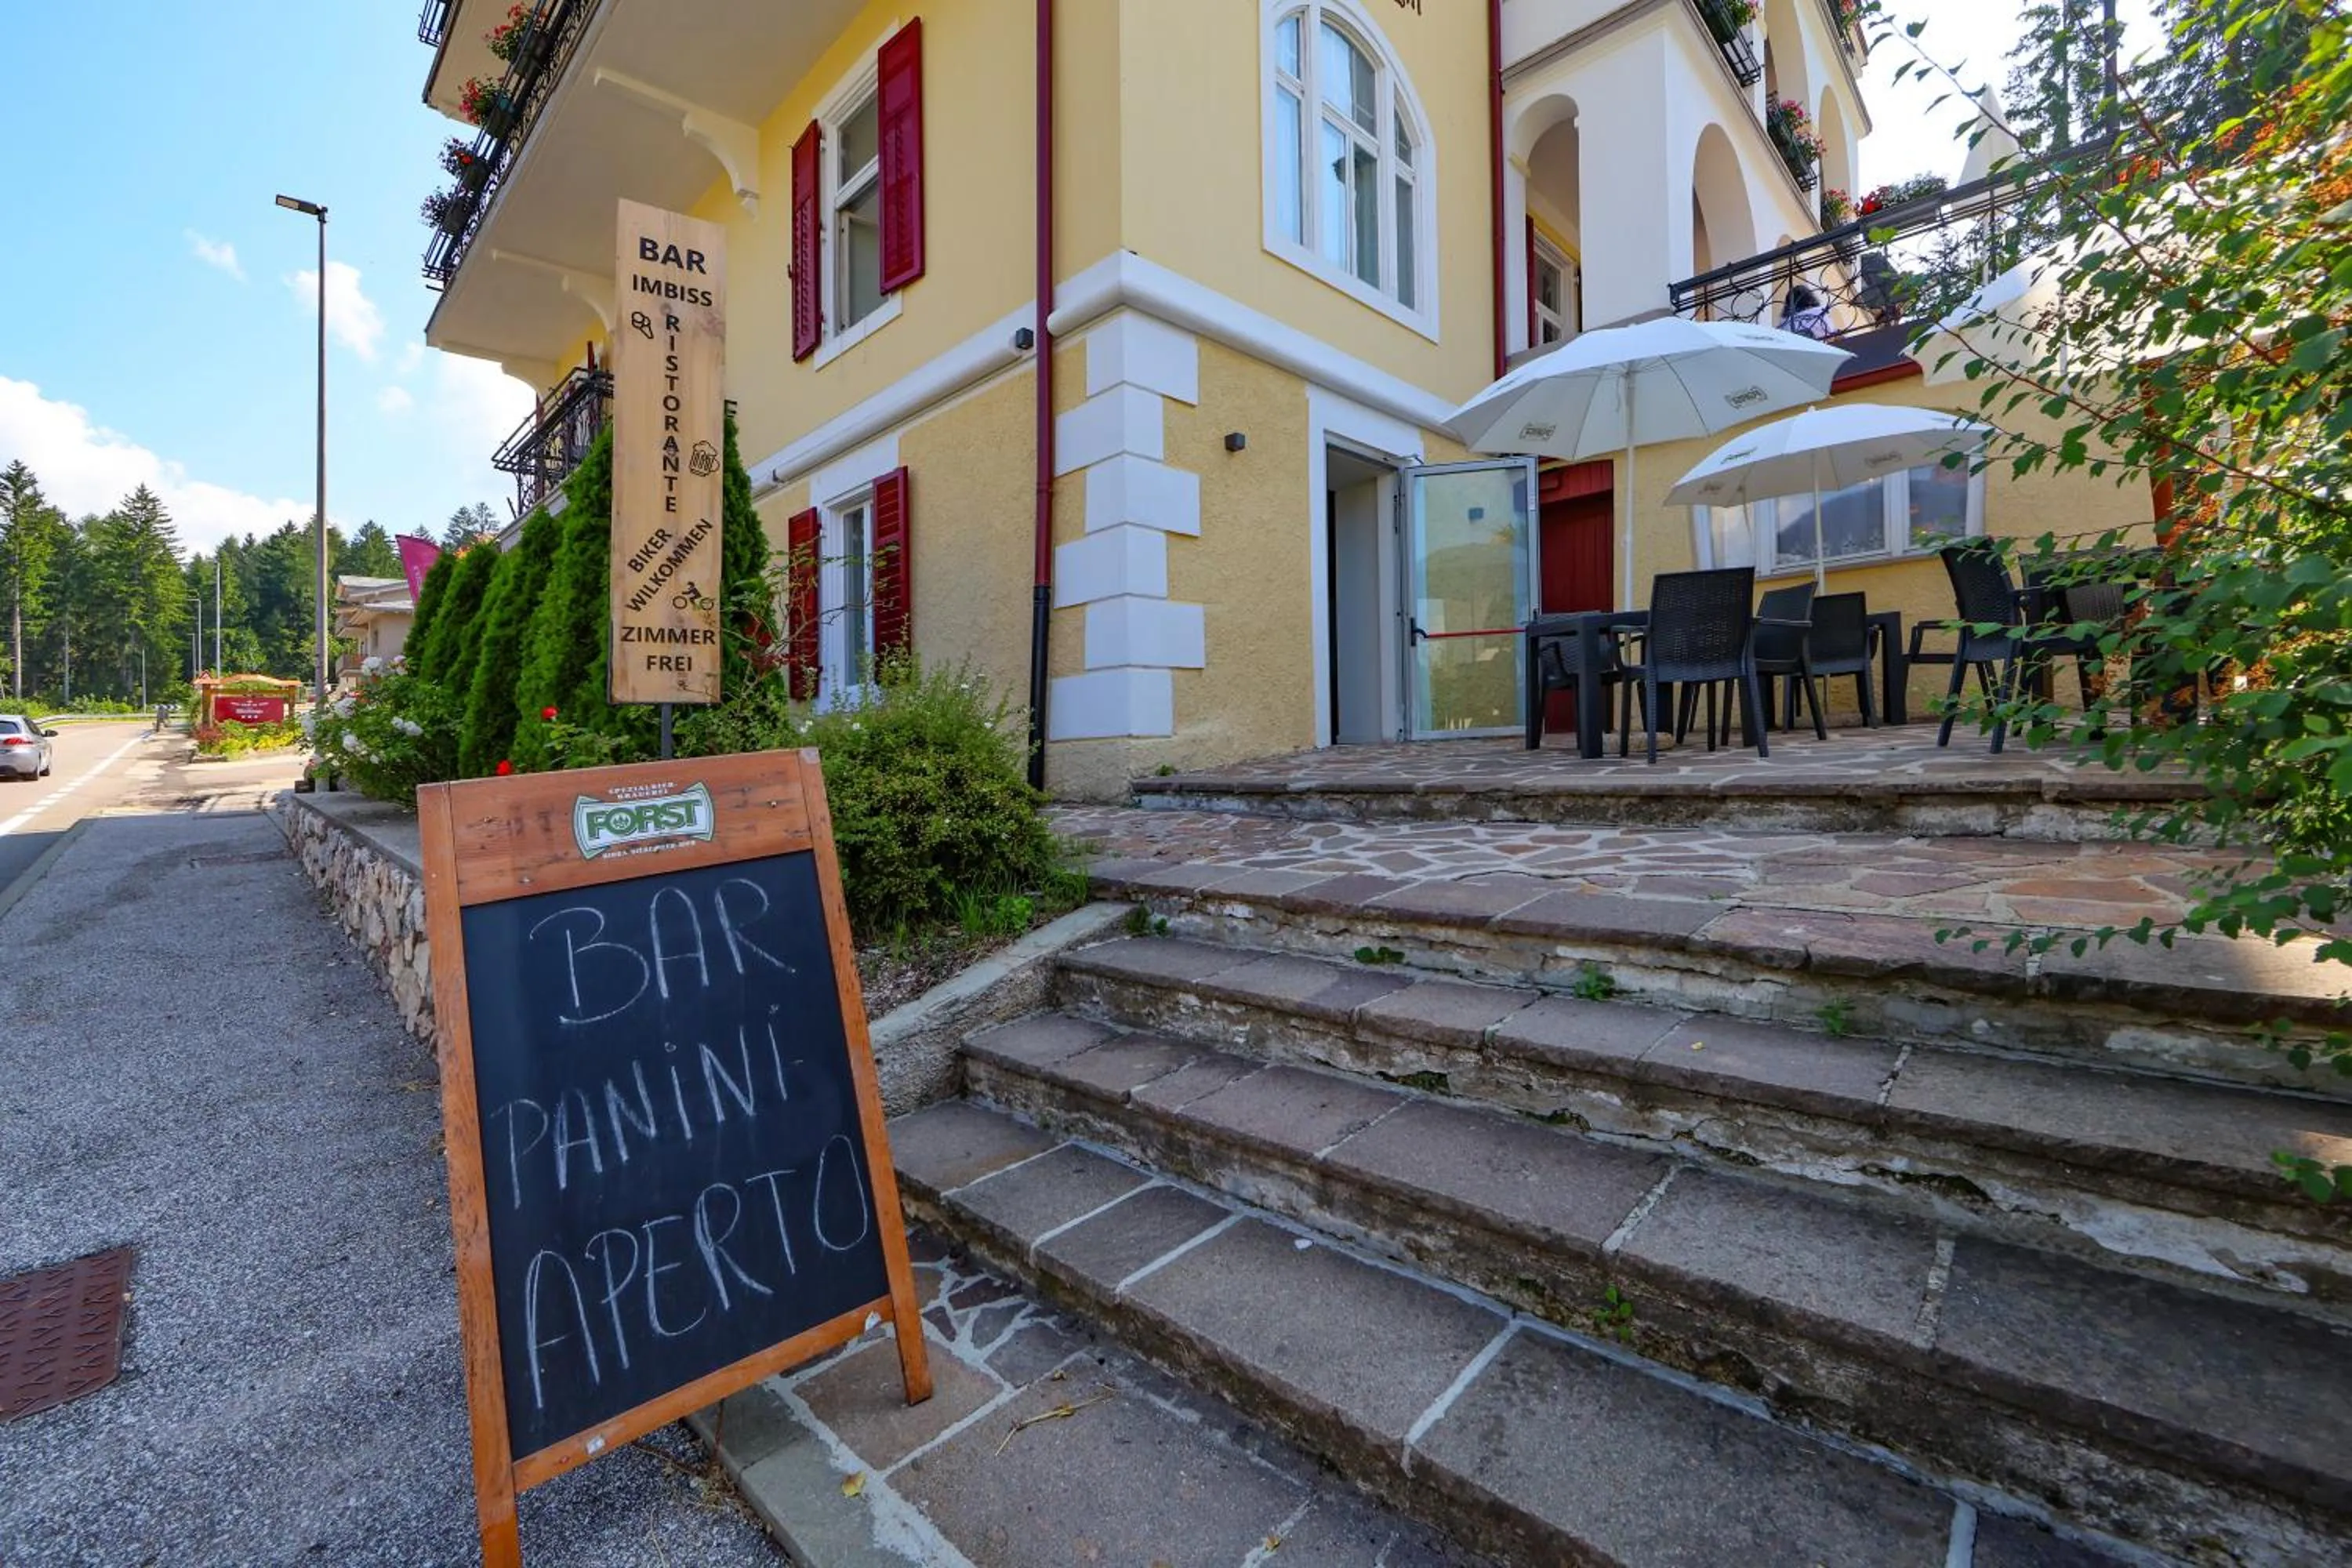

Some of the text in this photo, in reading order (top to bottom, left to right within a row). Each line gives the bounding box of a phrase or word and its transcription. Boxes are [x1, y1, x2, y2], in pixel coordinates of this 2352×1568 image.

[640, 236, 706, 274] BAR
[633, 274, 713, 307] IMBISS
[662, 313, 681, 513] RISTORANTE
[625, 518, 713, 612] WILKOMMEN
[628, 528, 673, 573] BIKER
[620, 626, 716, 645] ZIMMER
[646, 655, 692, 672] FREI
[586, 799, 704, 839] FORST
[529, 878, 797, 1024] BAR
[524, 1134, 869, 1409] APERTO
